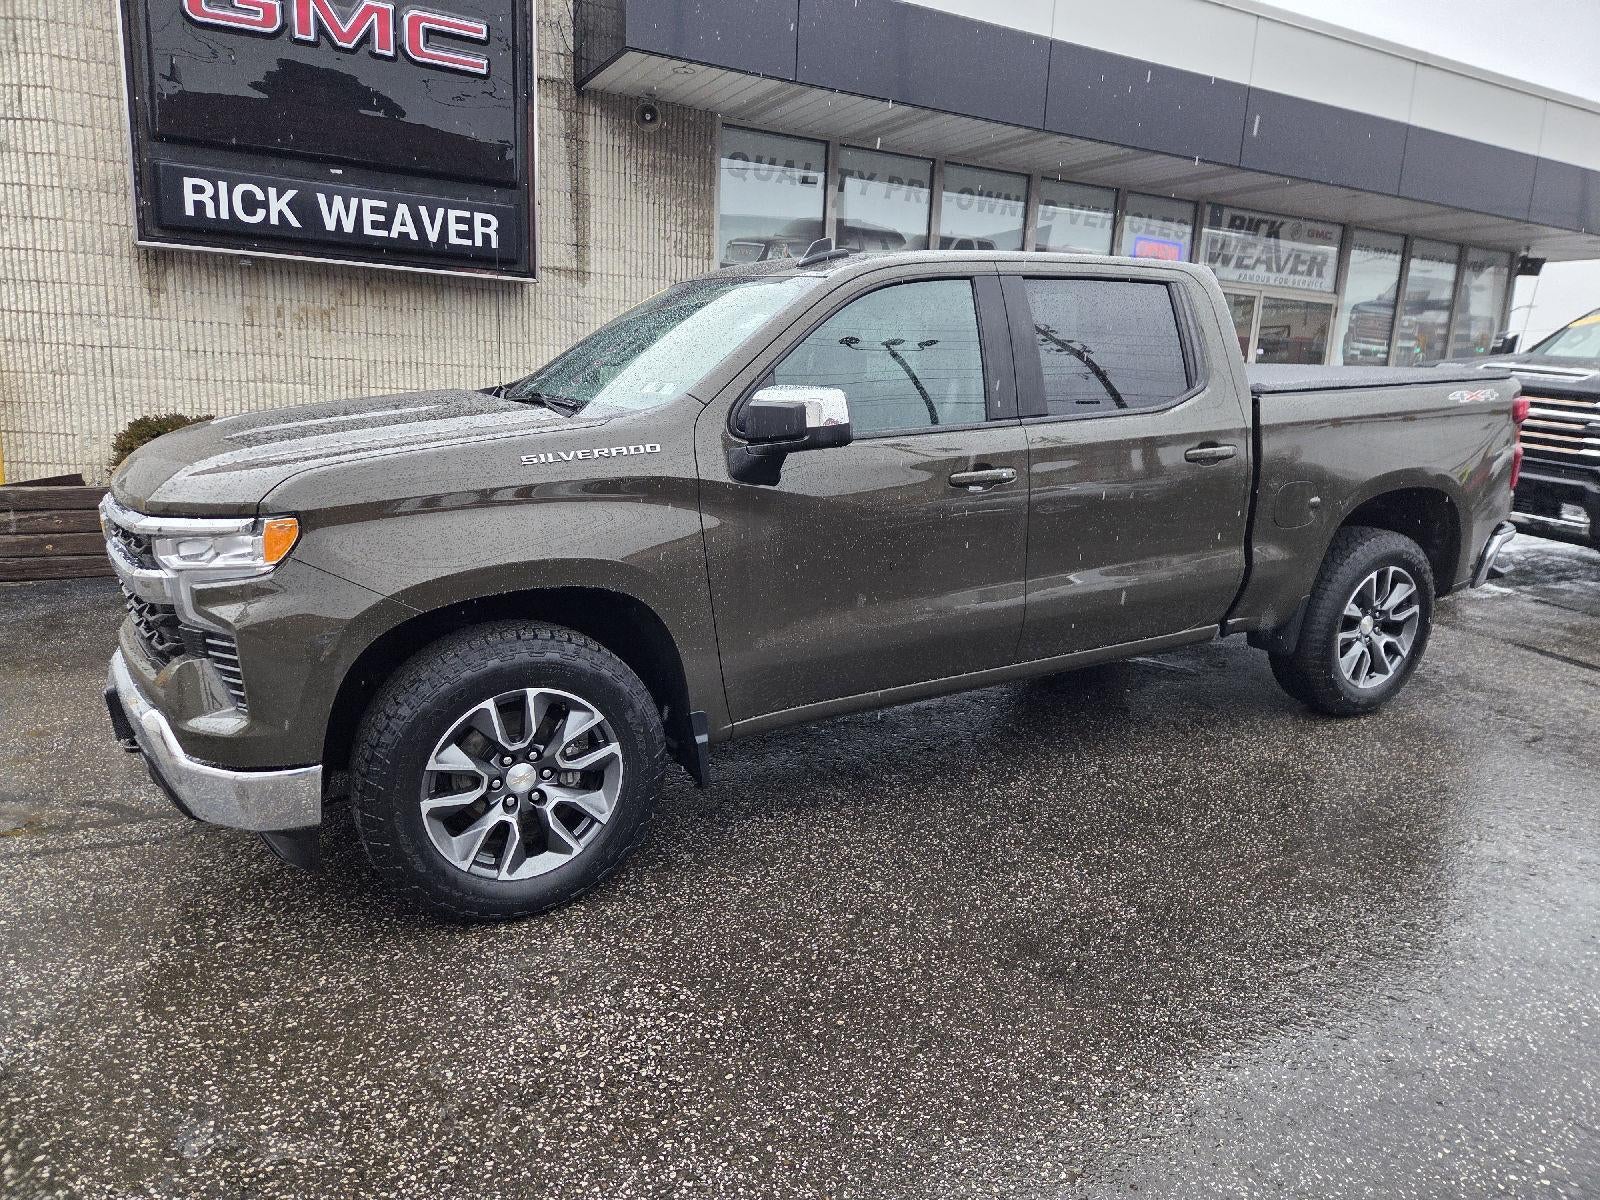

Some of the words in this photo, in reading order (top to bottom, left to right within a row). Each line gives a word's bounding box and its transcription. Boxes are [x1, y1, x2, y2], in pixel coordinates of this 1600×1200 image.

[182, 0, 490, 76] GMC
[182, 177, 302, 228] RICK
[317, 192, 499, 249] WEAVER
[1226, 213, 1286, 243] RICK
[1306, 229, 1333, 240] GMC
[1208, 234, 1329, 279] WEAVER
[1238, 272, 1271, 283] FAMOUS
[1273, 276, 1289, 286] FOR
[520, 443, 661, 466] SILVERADO
